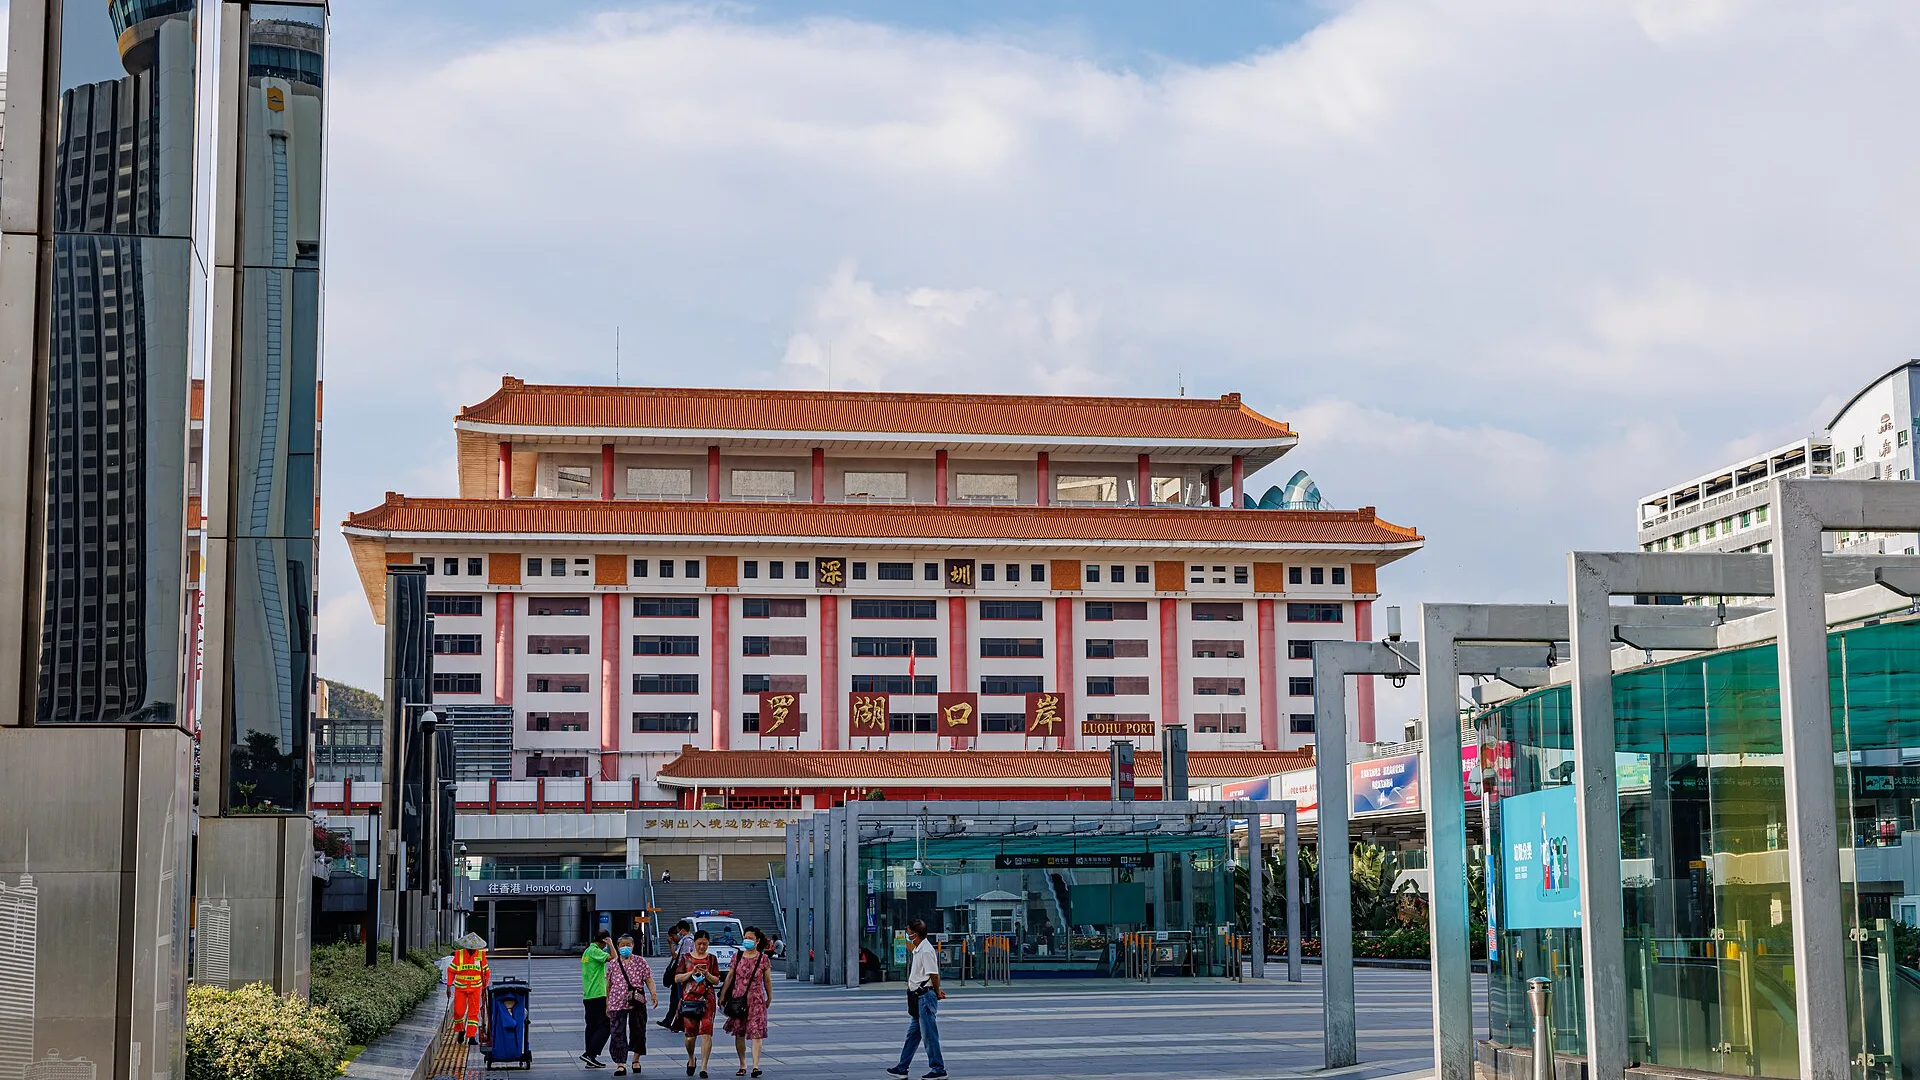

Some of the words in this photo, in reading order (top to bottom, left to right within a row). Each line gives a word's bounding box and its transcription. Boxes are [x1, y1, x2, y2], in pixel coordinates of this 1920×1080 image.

[820, 560, 971, 585] 深圳
[766, 694, 1062, 736] 罗湖口岸
[1083, 723, 1121, 734] LUOHU
[1126, 723, 1154, 734] PORT
[644, 819, 799, 829] 罗湖出入境边防检查
[488, 883, 521, 894] 往香港
[525, 884, 572, 893] HongKong
